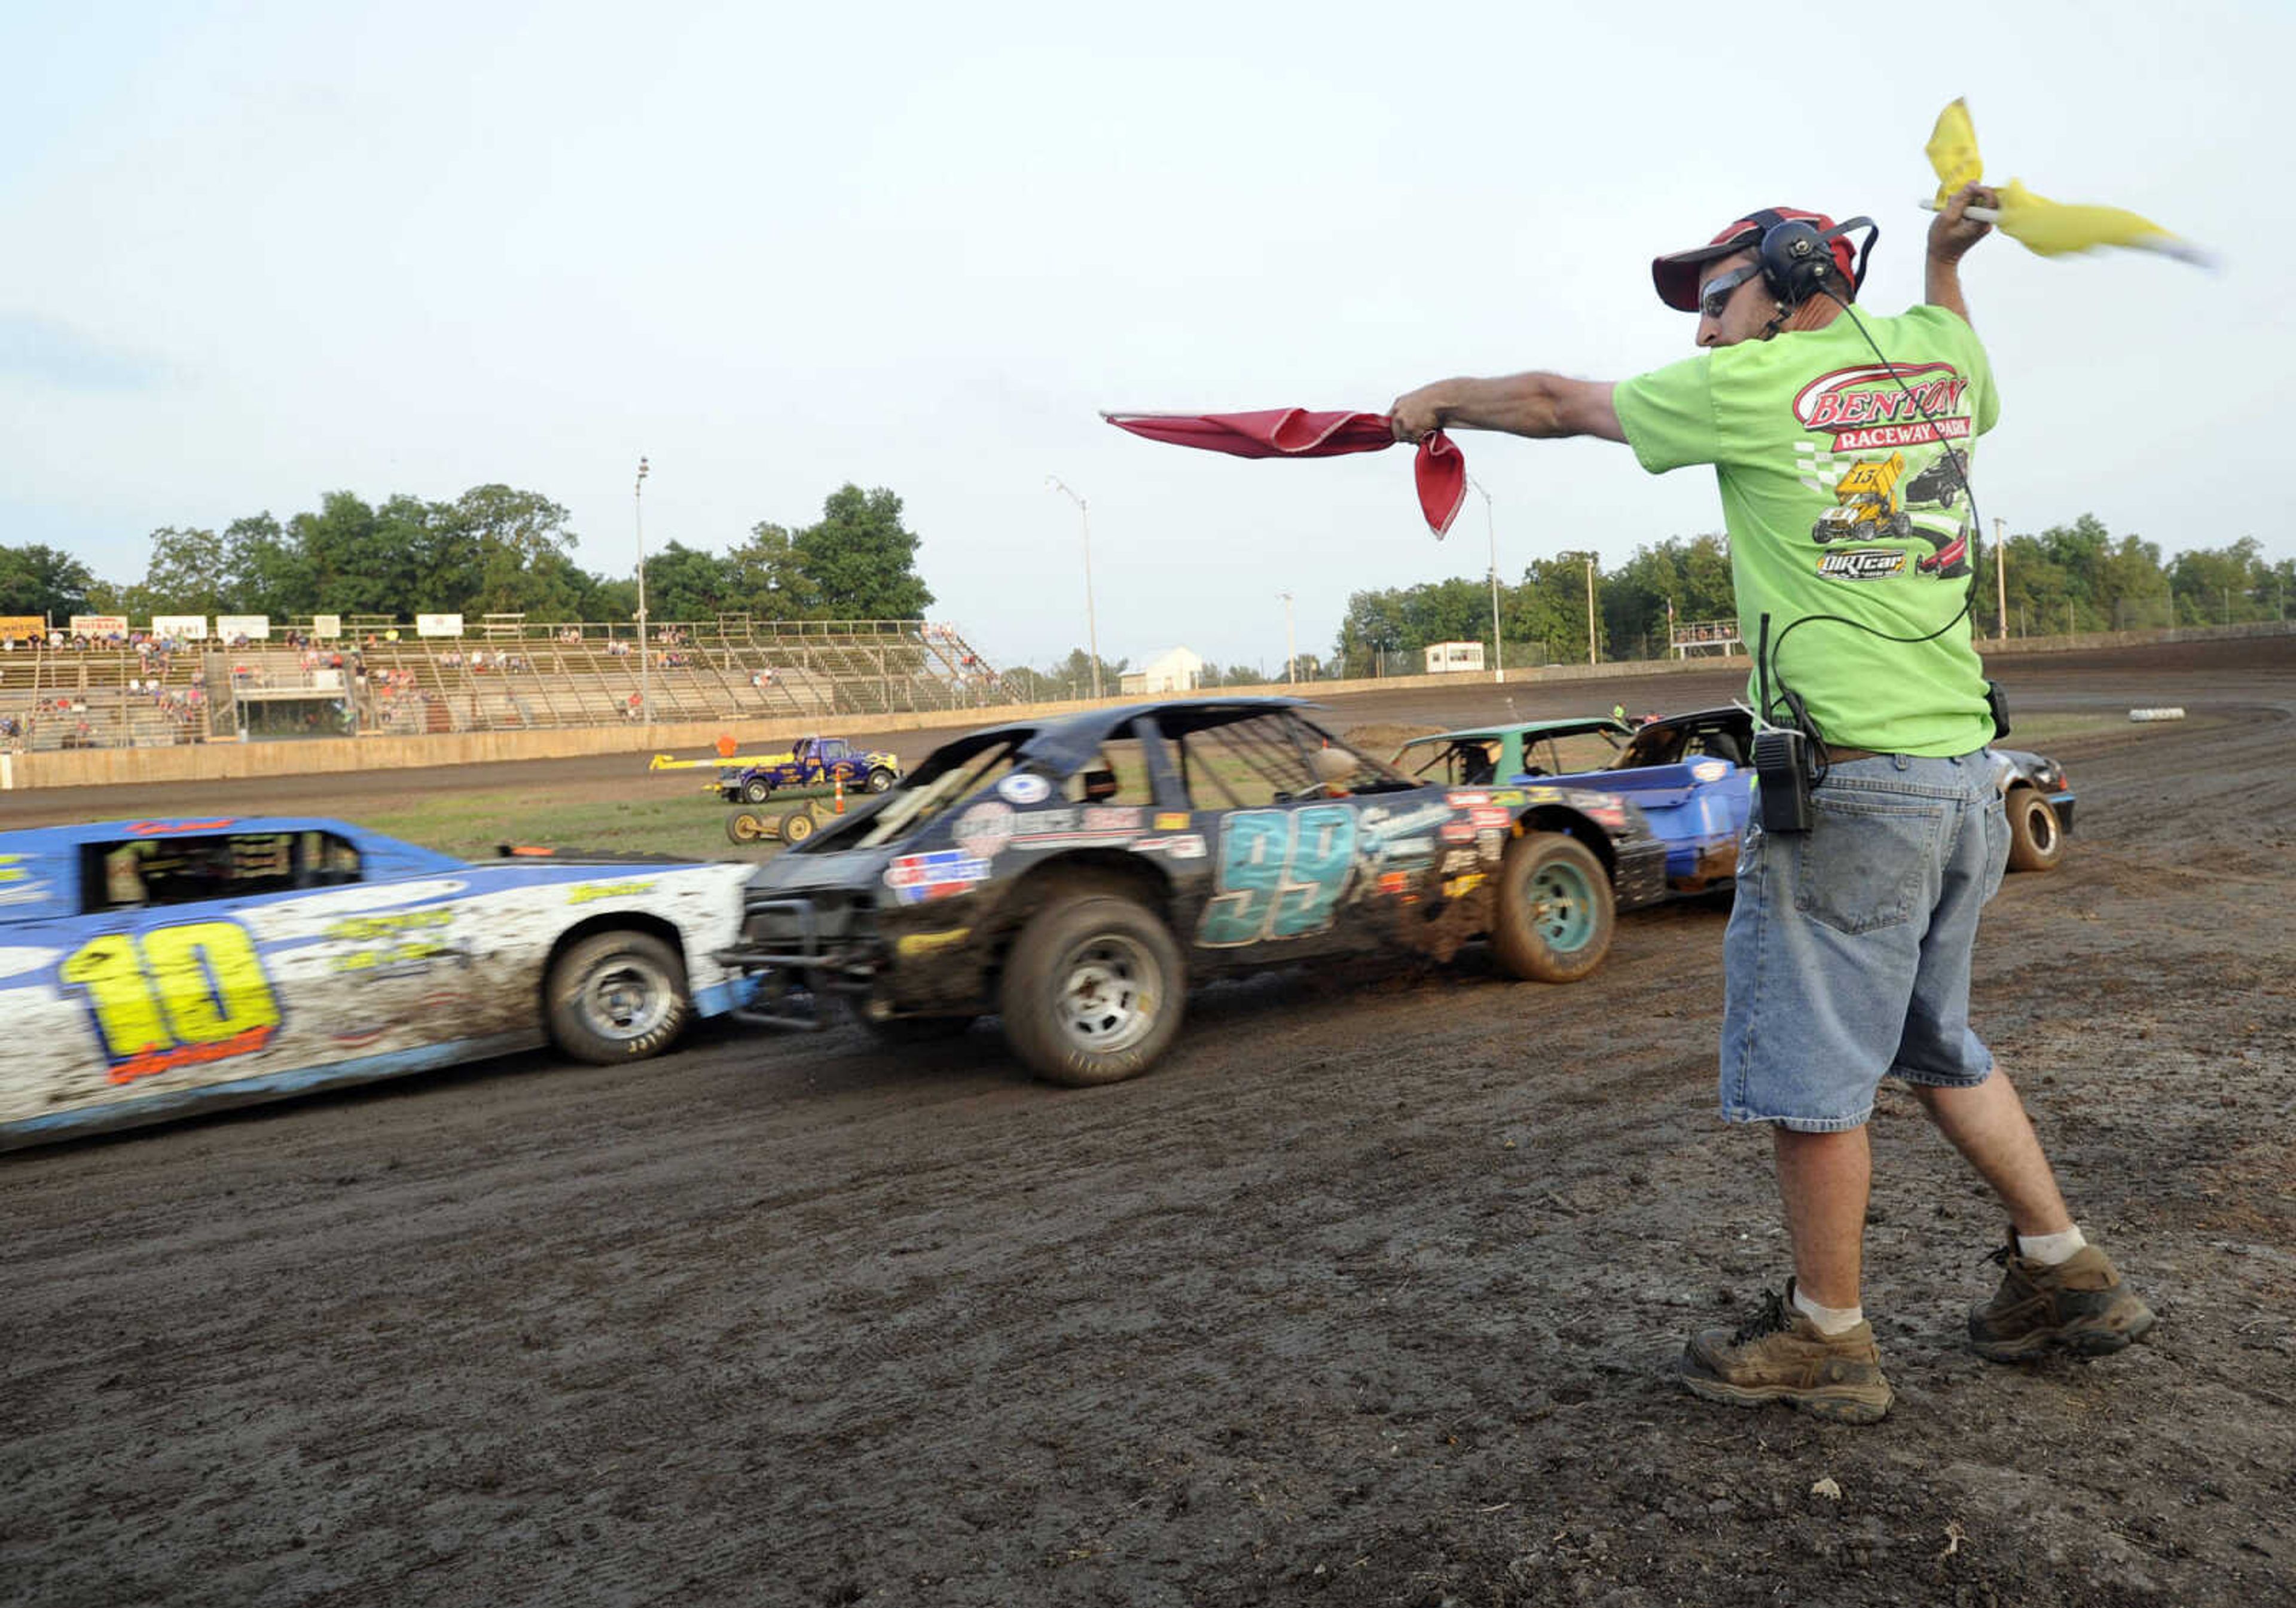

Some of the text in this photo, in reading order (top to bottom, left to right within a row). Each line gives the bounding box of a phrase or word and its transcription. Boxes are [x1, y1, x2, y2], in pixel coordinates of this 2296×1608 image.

[1804, 378, 1968, 430] BENTON
[1840, 420, 1968, 448] RACEWAY PARK
[1193, 803, 1358, 948] 99
[59, 919, 284, 1059] 10
